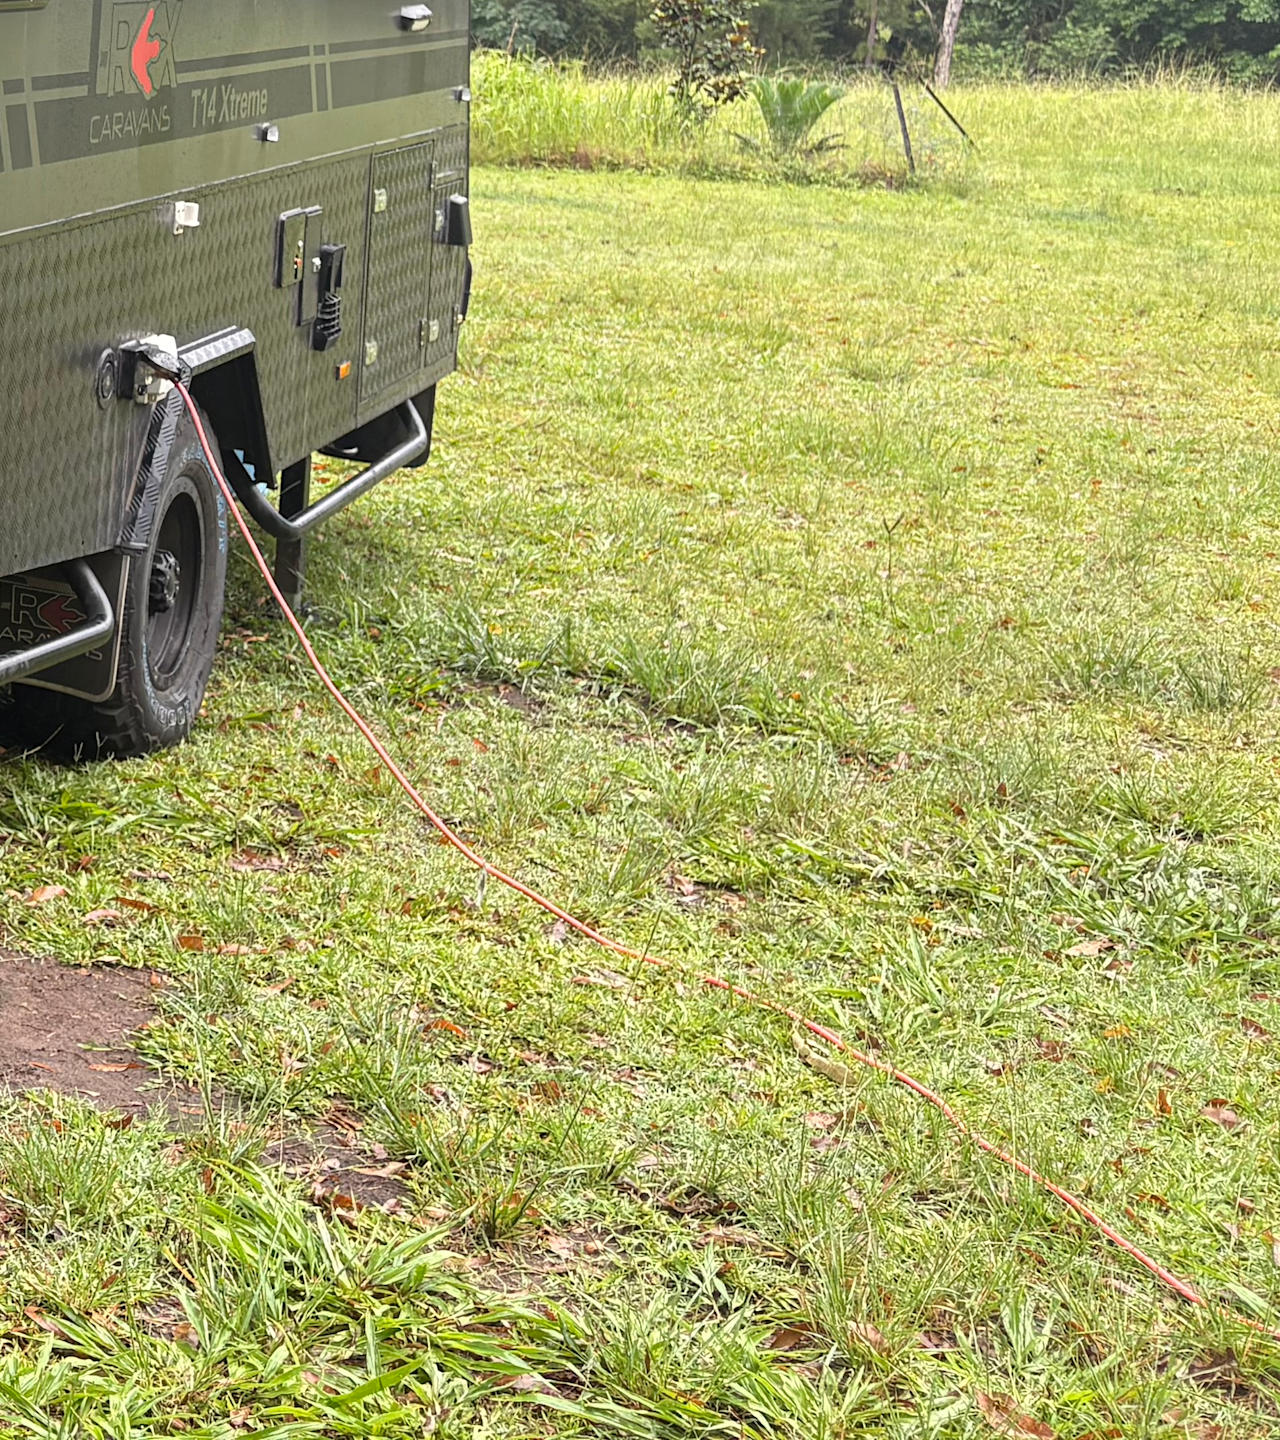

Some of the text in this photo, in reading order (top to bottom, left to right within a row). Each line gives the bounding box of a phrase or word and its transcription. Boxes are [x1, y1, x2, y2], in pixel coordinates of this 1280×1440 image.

[89, 105, 171, 144] CARAVANS
[191, 83, 268, 128] T14 Xtreme
